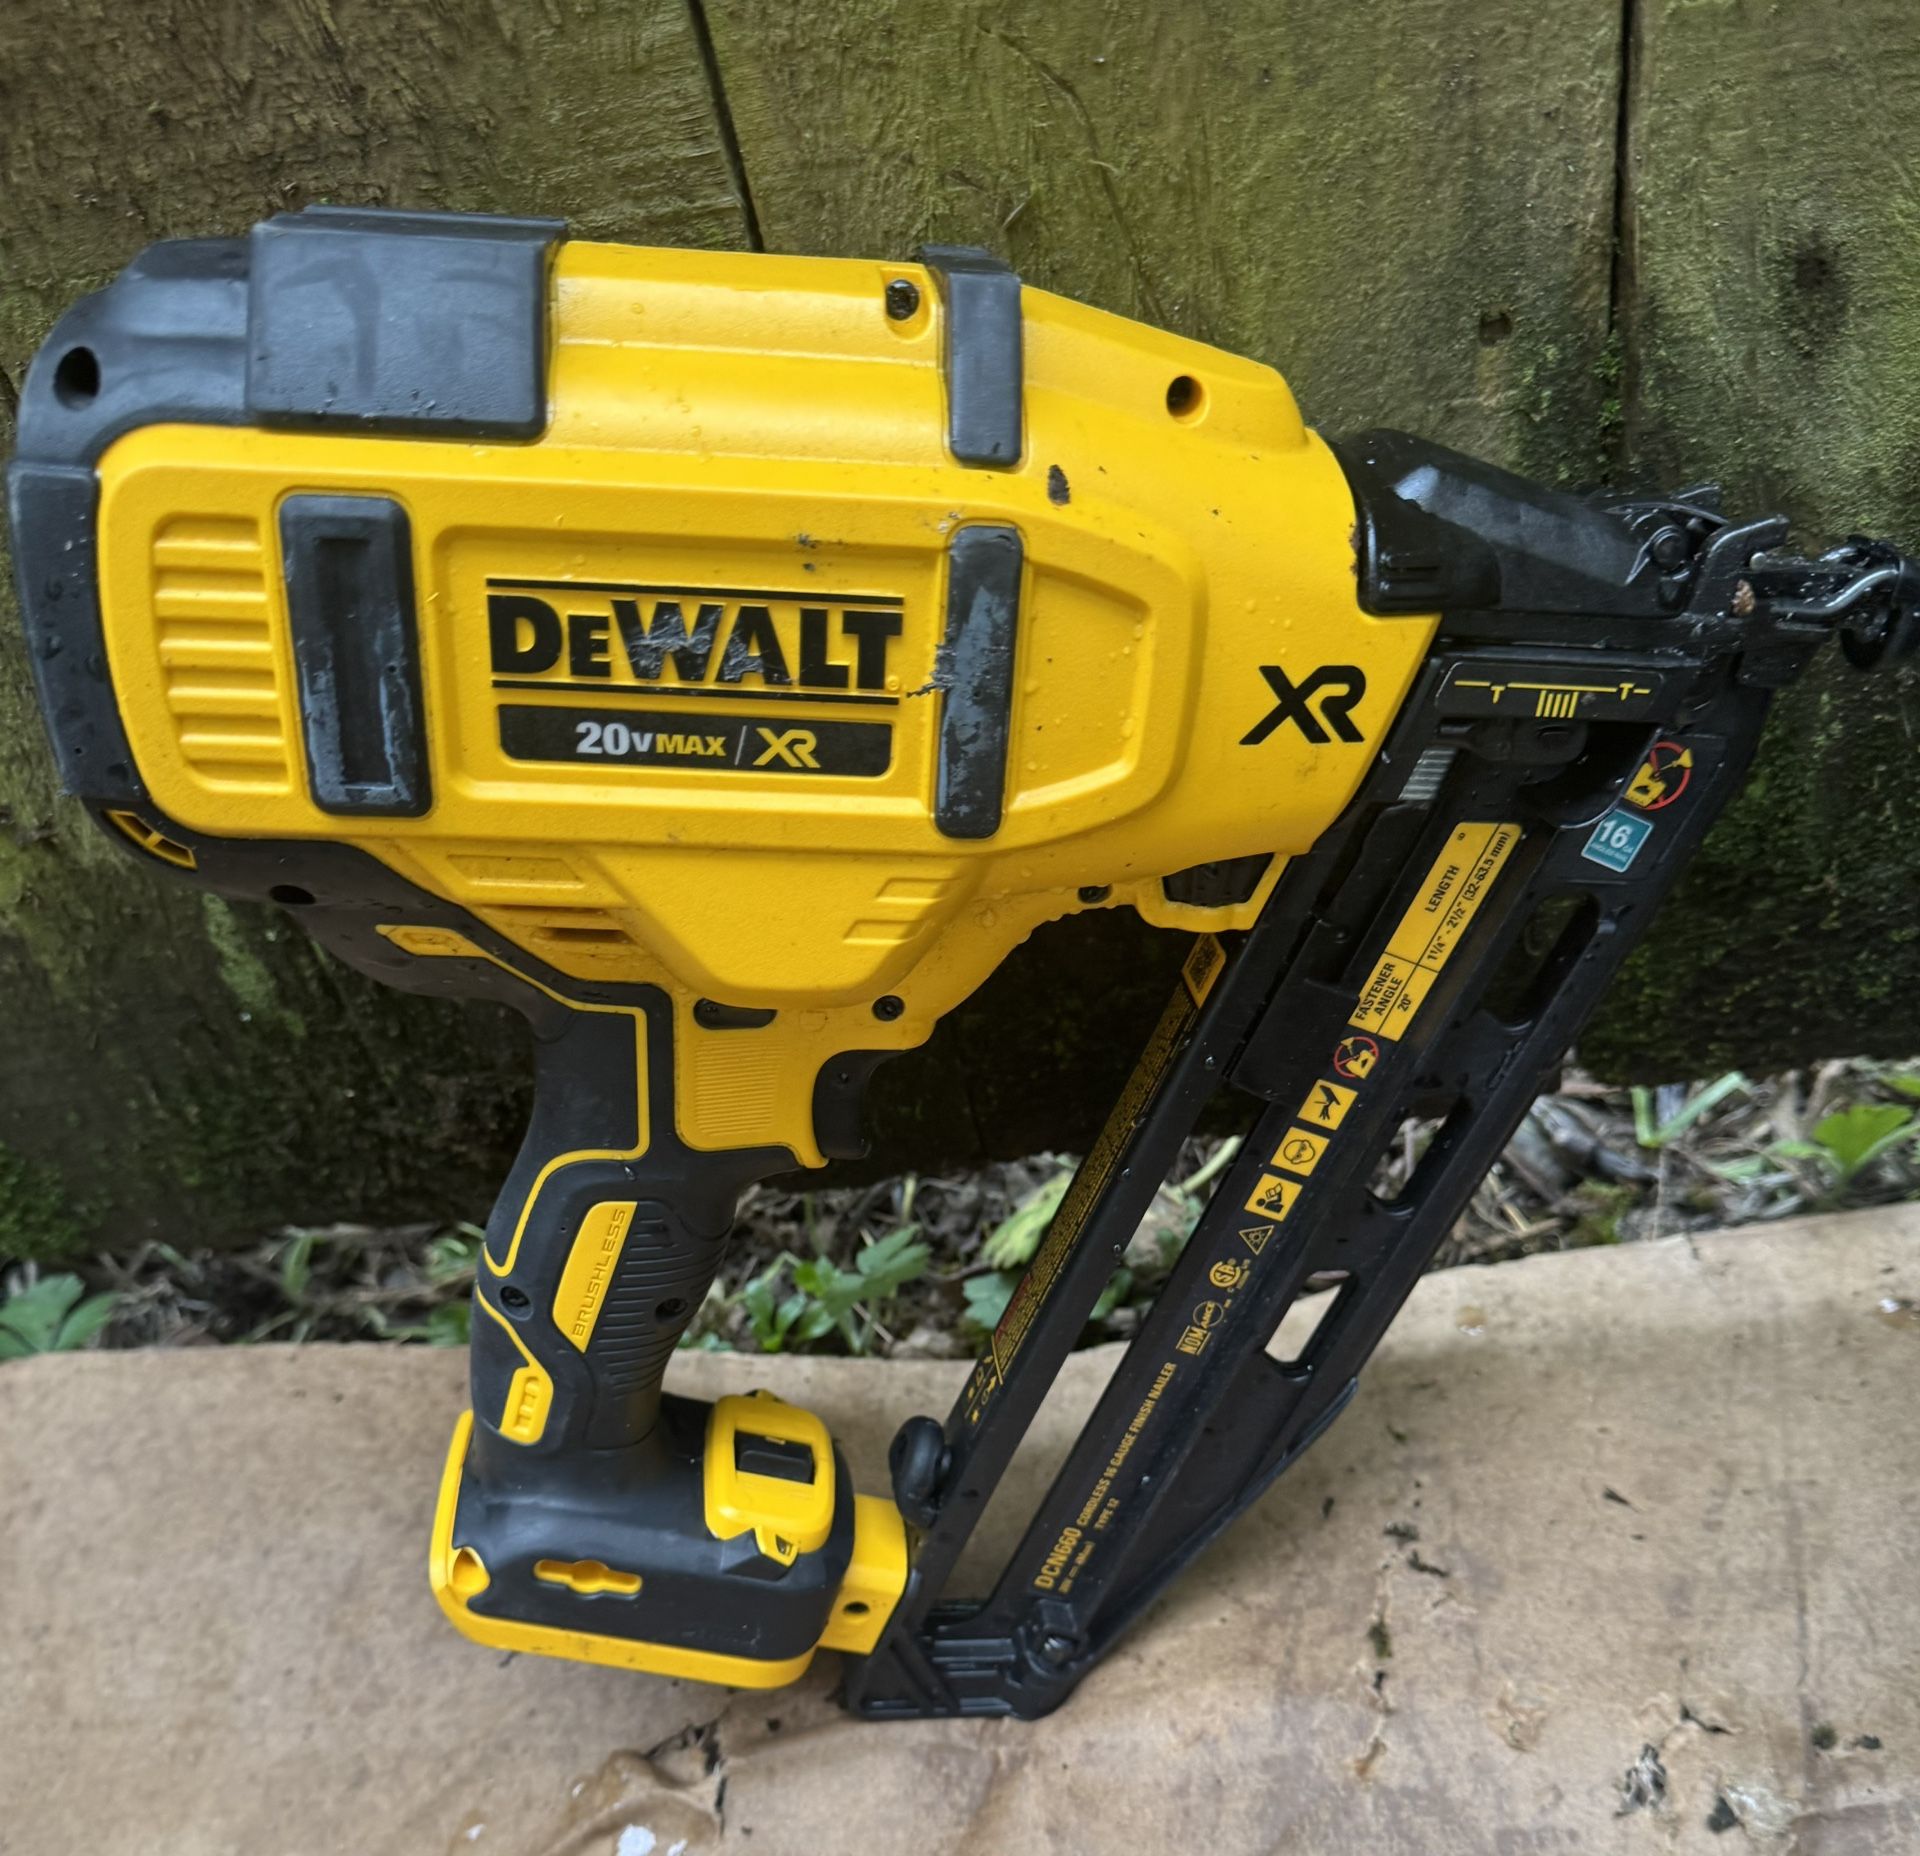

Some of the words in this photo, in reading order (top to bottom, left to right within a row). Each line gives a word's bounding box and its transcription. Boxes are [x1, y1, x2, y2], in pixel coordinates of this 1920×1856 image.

[1239, 664, 1367, 746] XR
[753, 727, 821, 769] XR
[1492, 830, 1511, 858] mm)
[1600, 819, 1633, 849] 16
[1425, 864, 1460, 914] LENGTH
[1355, 961, 1396, 1021] FASTENER
[1374, 977, 1403, 1016] ANGLE
[572, 1208, 626, 1337] BRUSHLESS
[1179, 1326, 1208, 1355] NOM
[1034, 1526, 1083, 1590] DCN660
[1076, 1477, 1111, 1527] CORDLESS
[1110, 1432, 1138, 1467] GAUGE
[1129, 1398, 1157, 1433] FINISH
[1147, 1361, 1178, 1400] NAILER
